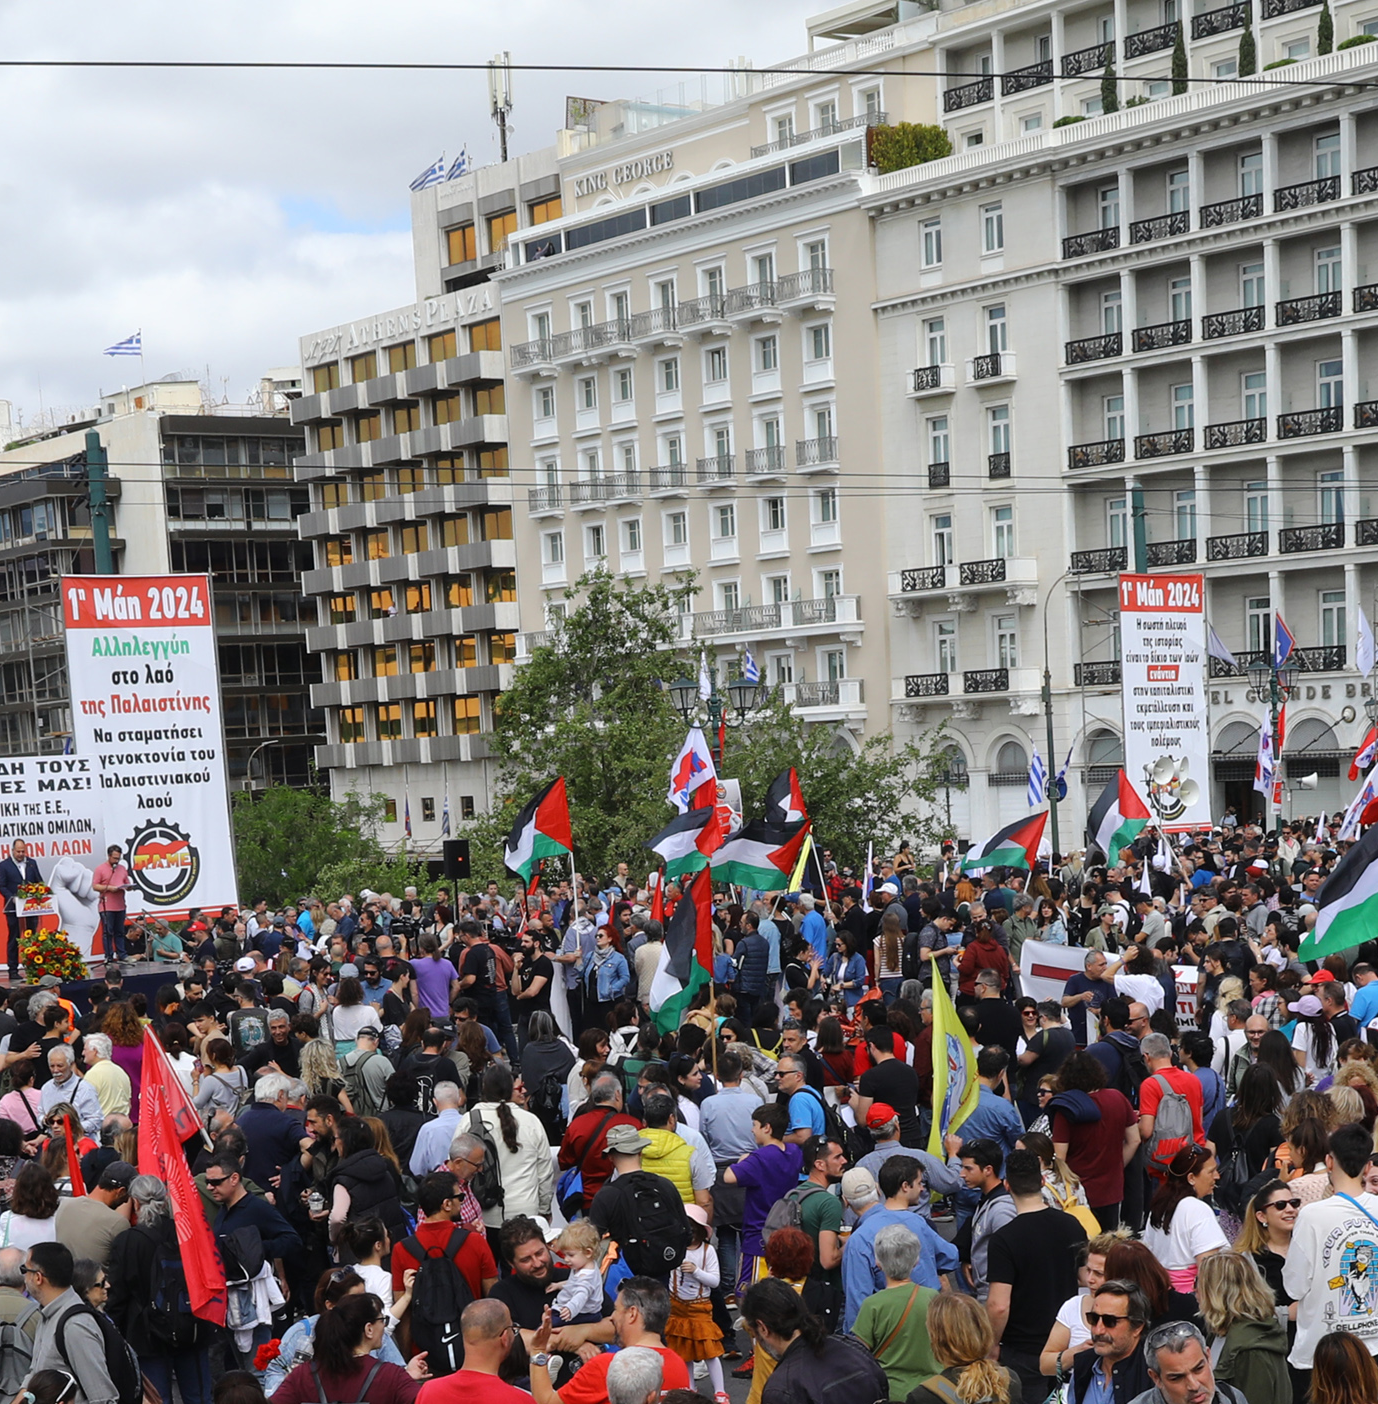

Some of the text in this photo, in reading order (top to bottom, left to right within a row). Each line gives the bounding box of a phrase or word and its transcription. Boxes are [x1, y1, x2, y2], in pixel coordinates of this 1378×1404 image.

[574, 151, 673, 197] KING GEORGE
[346, 308, 421, 350] ATHENS
[424, 290, 493, 327] PLAZA
[93, 584, 142, 620] Μάη
[147, 587, 204, 619] 2024
[1136, 579, 1164, 606] Μάη
[1167, 582, 1199, 607] 2024
[1136, 618, 1141, 630] Η
[92, 633, 190, 660] Αλληλεγγύη
[112, 662, 174, 685] στο λαό
[81, 690, 210, 718] της Παλαιστίνης
[94, 723, 202, 744] Να σταματήσει
[36, 760, 90, 773] ΤΟΥΣ
[99, 746, 214, 768] γενοκτονία του
[38, 778, 91, 792] ΜΑΣ!
[23, 803, 41, 815] ΤΗΣ
[137, 792, 172, 809] λαού
[48, 819, 95, 835] ΟΜΙΛΩΝ,
[25, 842, 44, 857] ΩΝ
[51, 839, 92, 856] ΛΑΩΝ
[1322, 1227, 1343, 1268] YOUR
